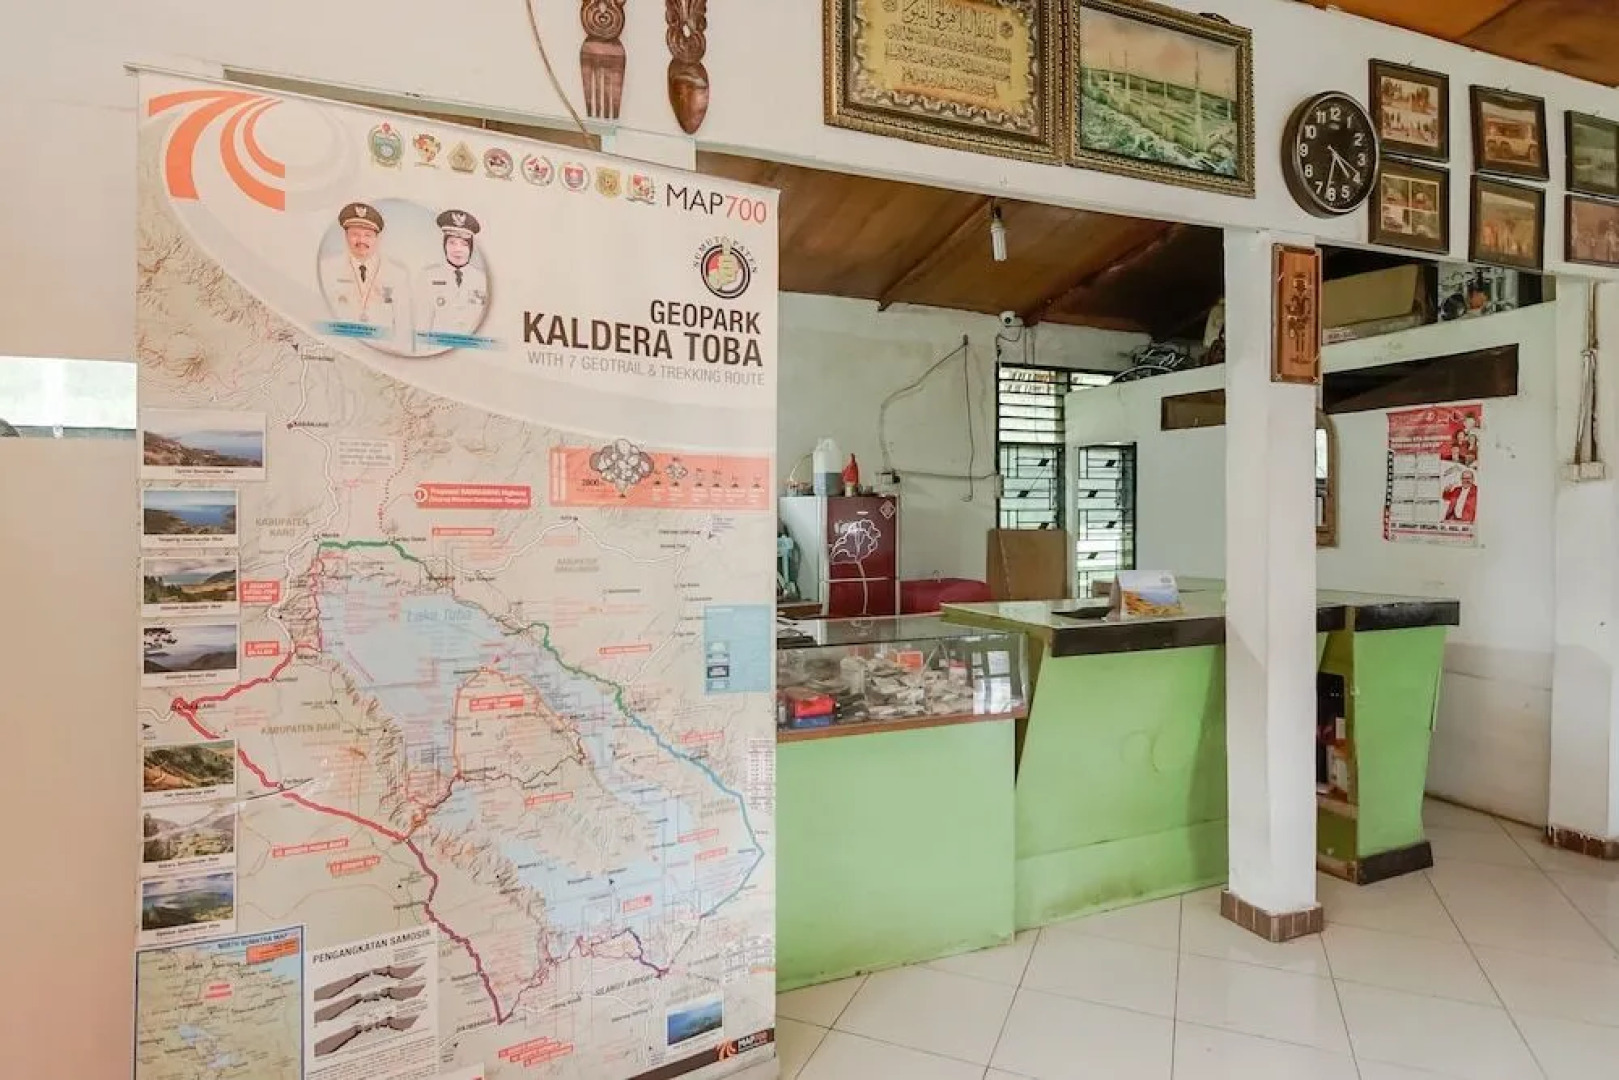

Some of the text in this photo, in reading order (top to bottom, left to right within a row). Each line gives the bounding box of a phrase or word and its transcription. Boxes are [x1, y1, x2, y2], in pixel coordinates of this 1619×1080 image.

[1316, 111, 1326, 123] 11
[1330, 107, 1341, 121] 12
[1346, 116, 1352, 128] 1
[1305, 125, 1317, 139] 10
[1354, 133, 1364, 147] 2
[1300, 144, 1308, 157] 9
[1357, 153, 1366, 166] 3
[1305, 164, 1313, 177] 8
[1353, 172, 1361, 184] 4
[1315, 181, 1323, 194] 7
[1327, 187, 1336, 202] 6
[1341, 185, 1350, 198] 5
[666, 184, 767, 223] MAP700
[650, 300, 761, 335] GEOPARK
[523, 311, 673, 359] KALDERA
[683, 332, 763, 367] TOBA
[527, 351, 765, 386] WITH 7 GEOTRAIL & TREKKING ROUTE
[312, 929, 431, 964] PENGANGKATAN SAMOSIR
